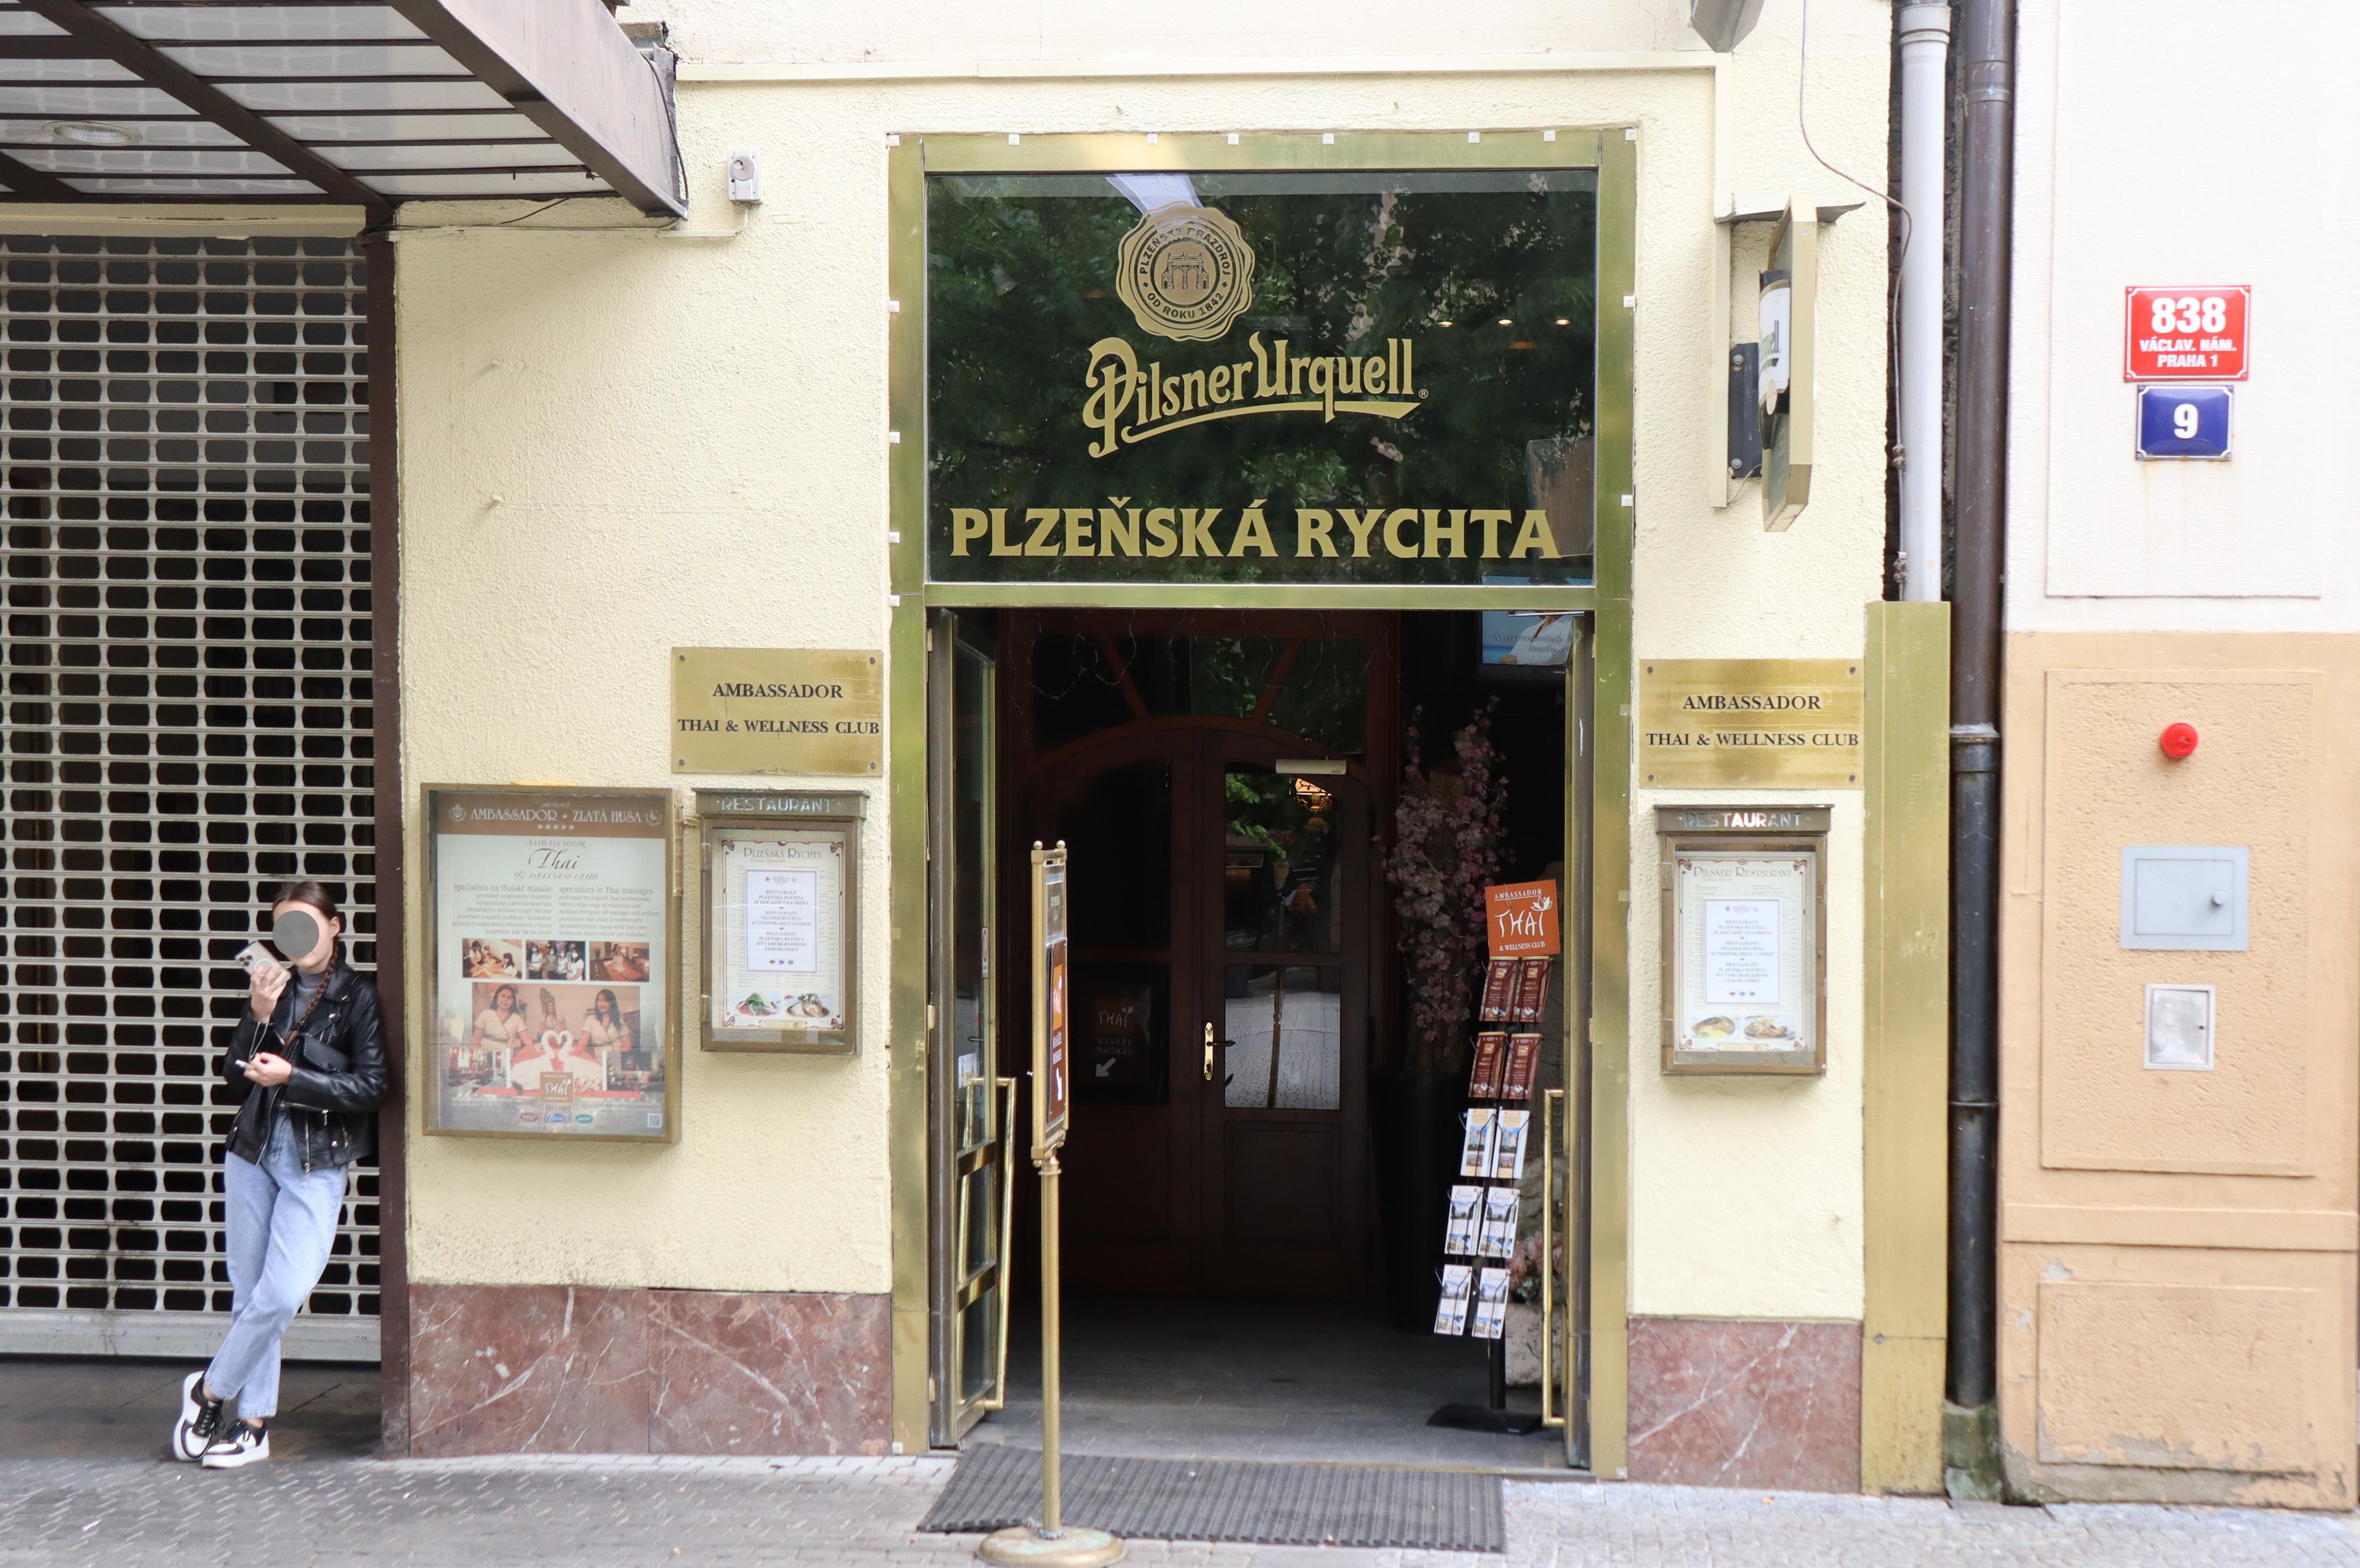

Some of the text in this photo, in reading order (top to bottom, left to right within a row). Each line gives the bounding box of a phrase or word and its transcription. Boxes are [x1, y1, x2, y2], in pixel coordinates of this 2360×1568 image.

[1187, 227, 1231, 275] PRAZDROJ
[1148, 292, 1224, 319] OD ROKU 1842
[2152, 297, 2225, 333] 838
[2139, 336, 2237, 352] VÁCLAV. NÁM.
[2157, 355, 2218, 368] PRAHA 1
[1082, 332, 1414, 458] Pilsner Urquell
[2174, 404, 2198, 439] 9
[949, 496, 1562, 559] PLZEŇSKÁ RYCHTA
[712, 683, 844, 698] AMBASSADOR
[1683, 695, 1822, 711] AMBASSADOR
[677, 719, 879, 735] THAI & WELLNESS CLUB
[1646, 733, 1859, 746] THAI & WELLNESS CLUB
[720, 797, 832, 813] RESTAURANT
[471, 808, 642, 823] AMBASSADOR ZLATÁ HUSA
[1684, 812, 1802, 828] RESTAURANT
[526, 839, 587, 848] AMBASSADOR
[528, 848, 580, 870] Thai
[743, 848, 822, 860] PLZEŇSKÁ RYCHTA
[1693, 867, 1792, 878] PILSNER RESTAURANT
[454, 884, 489, 892] specialista
[559, 886, 595, 894] specializes
[622, 887, 653, 896] massages
[1494, 889, 1542, 900] AMBASSADOR
[1494, 908, 1544, 939] THAI
[1097, 1009, 1128, 1028] THAI
